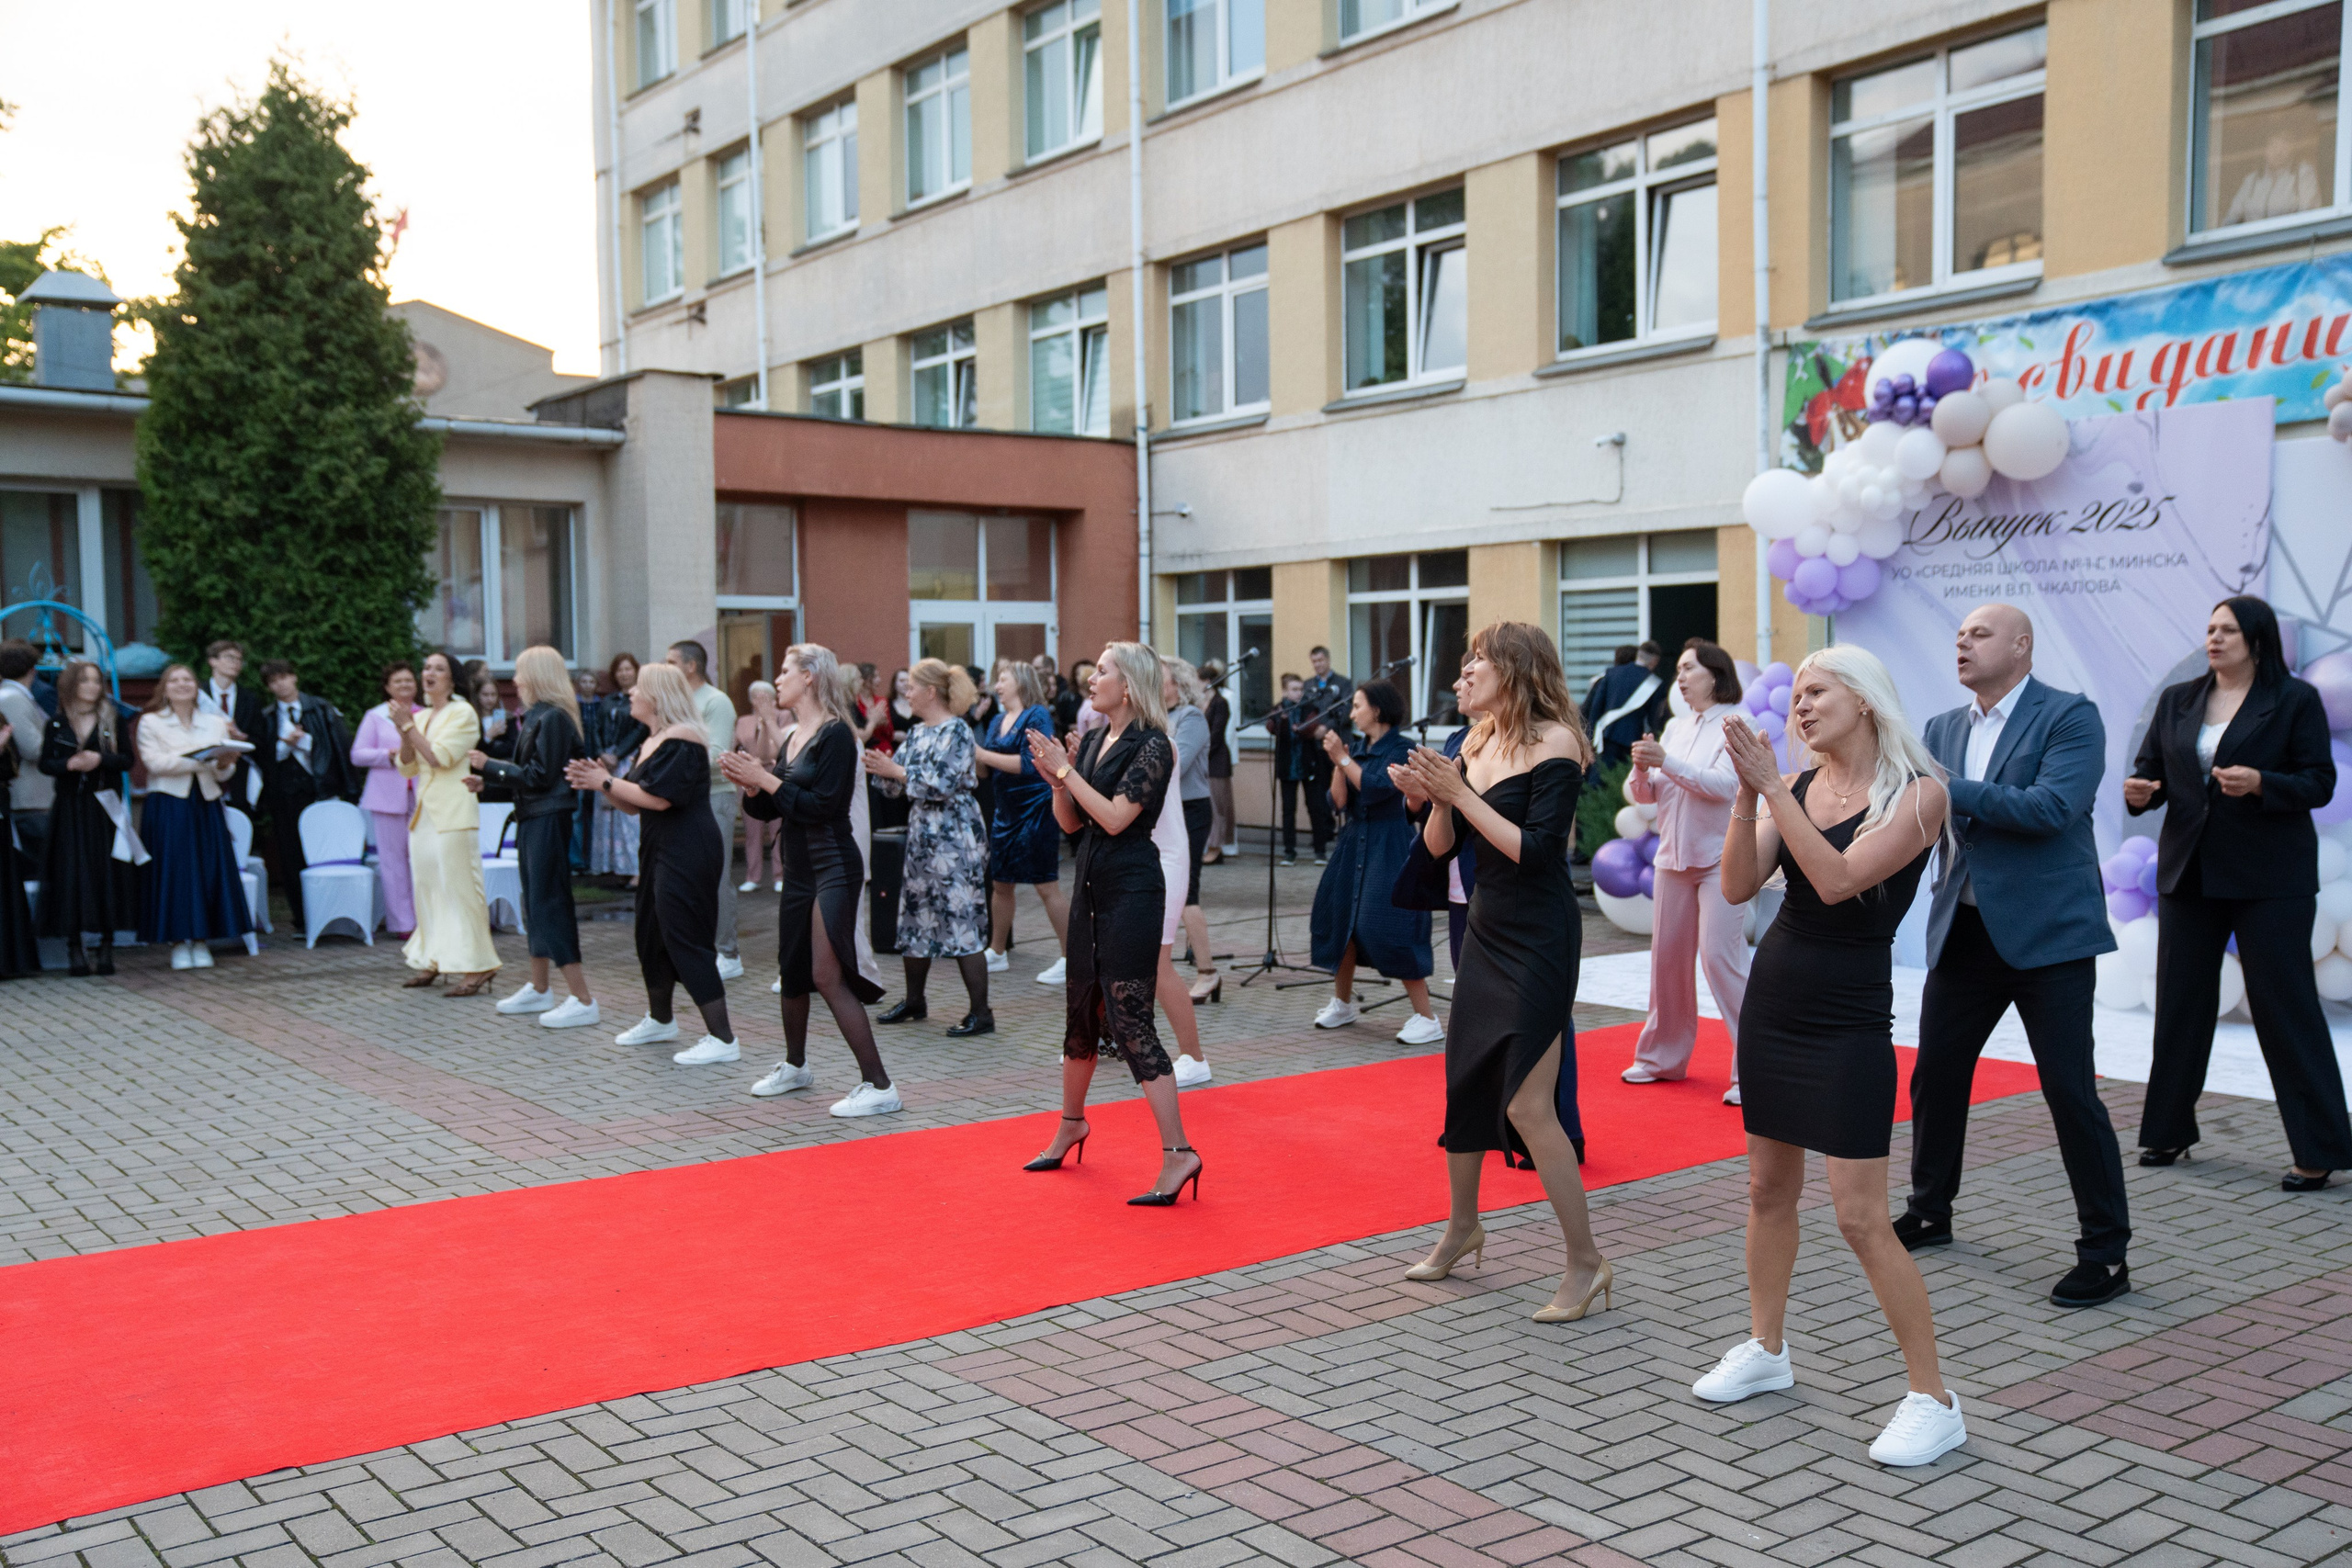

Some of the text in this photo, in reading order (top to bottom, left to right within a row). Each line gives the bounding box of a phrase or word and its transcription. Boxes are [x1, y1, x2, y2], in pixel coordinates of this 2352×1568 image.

[1902, 491, 2177, 561] Выпуск 2025
[1996, 558, 2060, 576] ШКОЛА
[2109, 552, 2189, 570] МИНСКА
[1943, 583, 2002, 599] ИМЕНИ
[2037, 578, 2122, 595] ЧКАЛОВА
